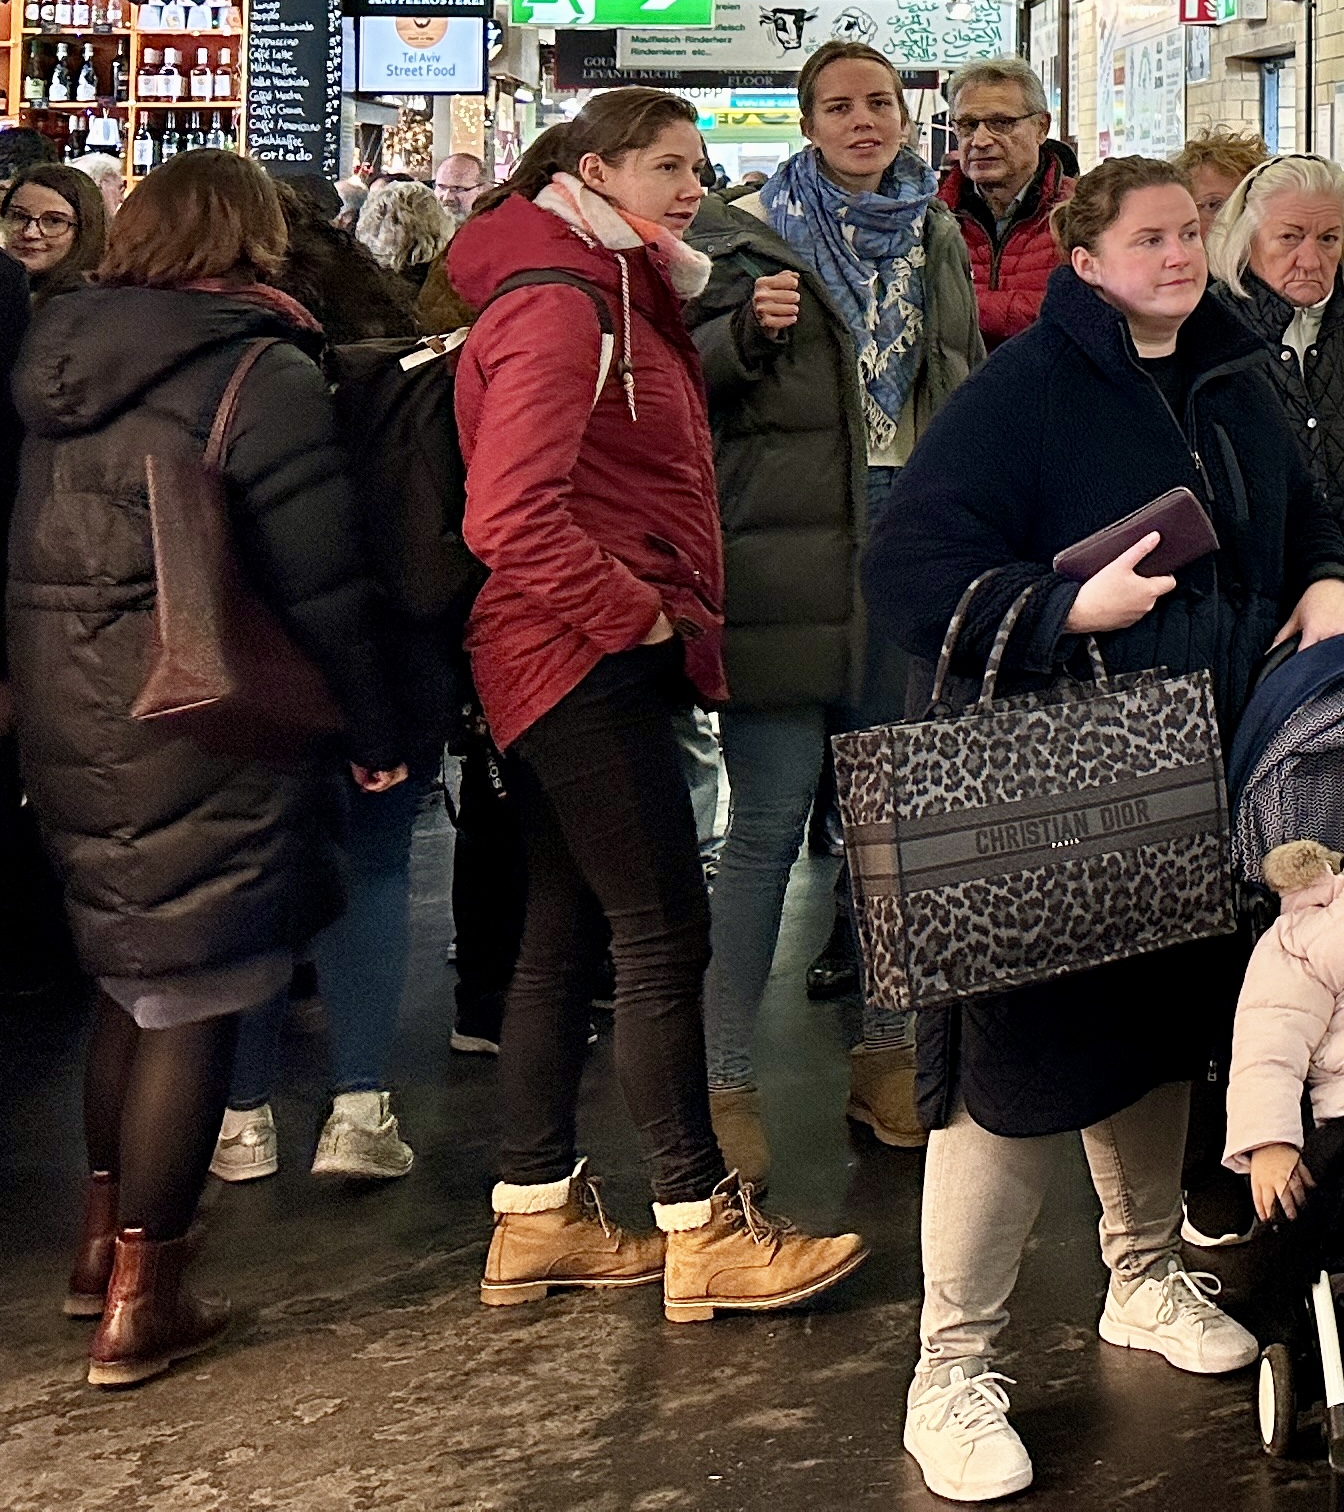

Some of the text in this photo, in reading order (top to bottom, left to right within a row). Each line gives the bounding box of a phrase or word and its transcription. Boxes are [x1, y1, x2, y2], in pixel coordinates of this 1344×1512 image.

[402, 53, 441, 63] Tel Aviv
[386, 64, 456, 76] Street Food
[583, 69, 636, 79] LEVANTE
[728, 76, 773, 86] FLOOR
[249, 148, 313, 161] Cortado
[975, 798, 1150, 855] CHRISTIAN DIOR
[1051, 838, 1080, 849] PARIS
